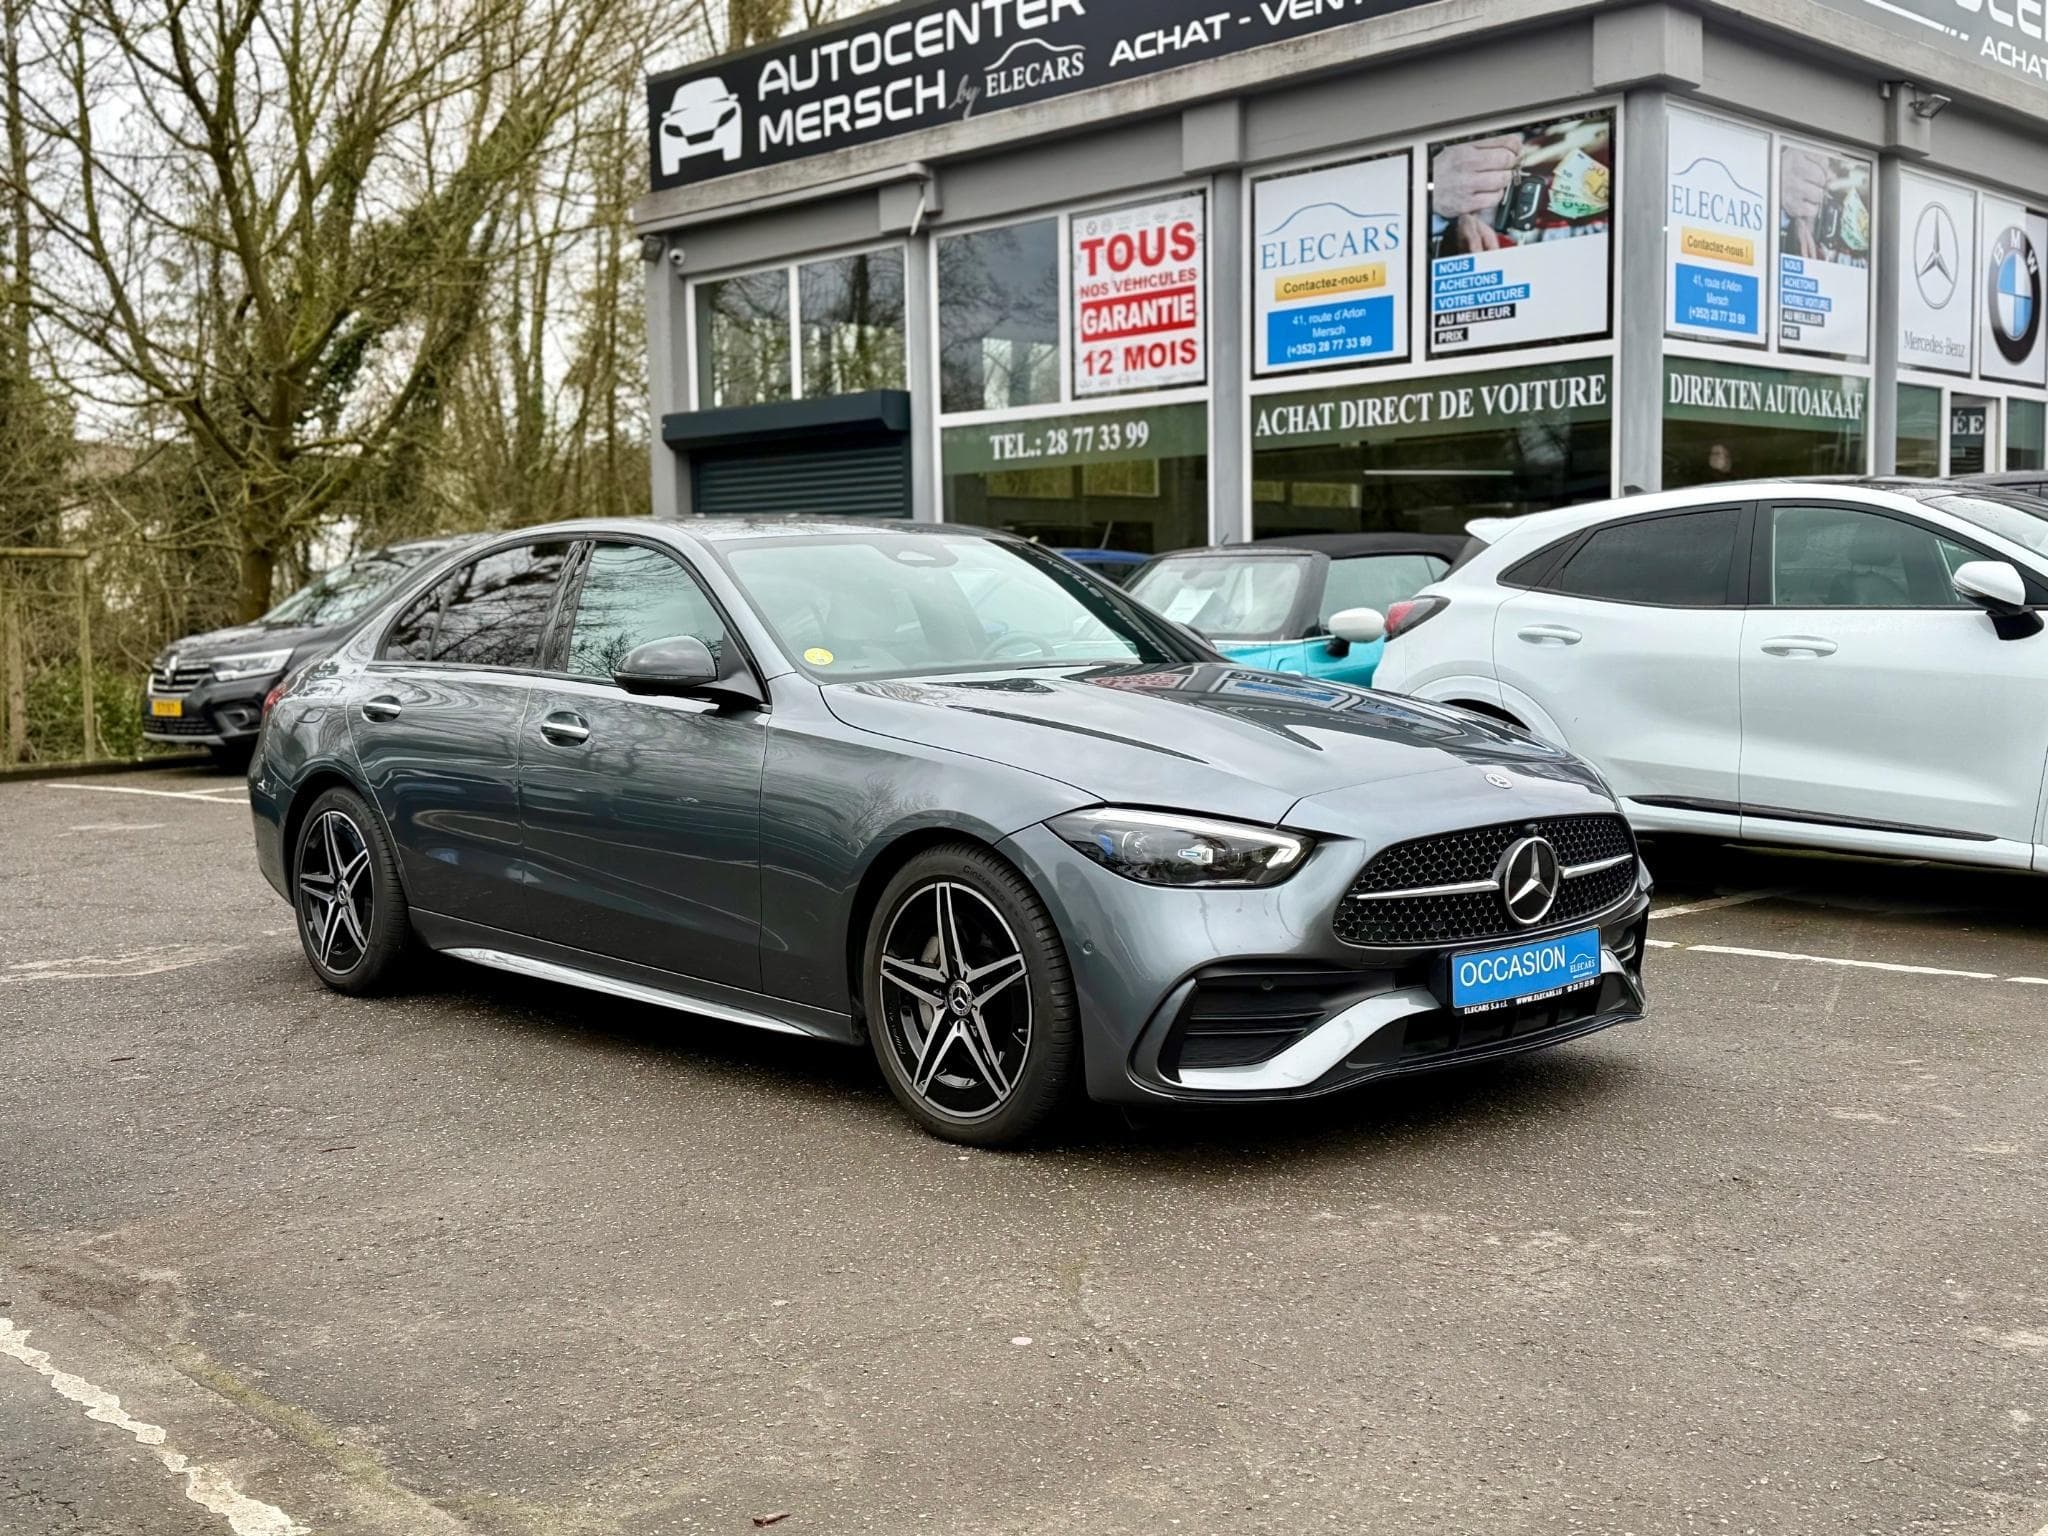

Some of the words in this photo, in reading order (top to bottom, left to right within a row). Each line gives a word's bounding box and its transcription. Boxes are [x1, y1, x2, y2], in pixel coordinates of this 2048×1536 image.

[1109, 12, 1231, 67] ACHAT
[1260, 0, 1362, 26] VEN
[759, 69, 945, 153] MERSCH
[949, 74, 981, 120] by
[986, 52, 1085, 97] ELECARS
[1672, 184, 1762, 231] ELECARS
[1080, 222, 1196, 277] TOUS
[1261, 223, 1400, 270] ELECARS
[1439, 260, 1470, 273] NOUS
[1081, 281, 1109, 298] NOS
[1112, 268, 1197, 293] VEHICULES
[1283, 272, 1369, 294] Contactez-nous
[1439, 274, 1498, 291] ACHETONS
[1439, 294, 1475, 309] VOTRE
[1477, 287, 1525, 306] VOITURE
[1083, 294, 1195, 335] GARANTIE
[1309, 312, 1333, 324] route
[1439, 314, 1453, 326] AU
[1456, 306, 1511, 323] MEILLEUR
[1312, 325, 1346, 338] Mersch
[1332, 338, 1344, 350] 77
[1345, 337, 1358, 349] 33
[1439, 330, 1464, 343] PRIX
[1904, 330, 1966, 357] Mercedes-Benz
[1083, 350, 1113, 376] 12
[1124, 338, 1197, 371] MOIS
[1255, 403, 1335, 437] ACHAT
[1340, 392, 1433, 429] DIRECT
[1439, 388, 1474, 420] DE
[1479, 374, 1606, 414] VOITURE
[1669, 373, 1761, 411] DIREKTEN
[1765, 385, 1863, 420] AUTOAKAAF
[990, 433, 1042, 460] TEL.:
[1046, 428, 1069, 455] 28
[1072, 426, 1094, 453] 77
[1099, 423, 1121, 451] 33
[1125, 420, 1149, 448] 99
[1460, 945, 1566, 987] OCCASION
[1570, 959, 1595, 974] ELECARS
[1464, 1005, 1489, 1015] ELECARS
